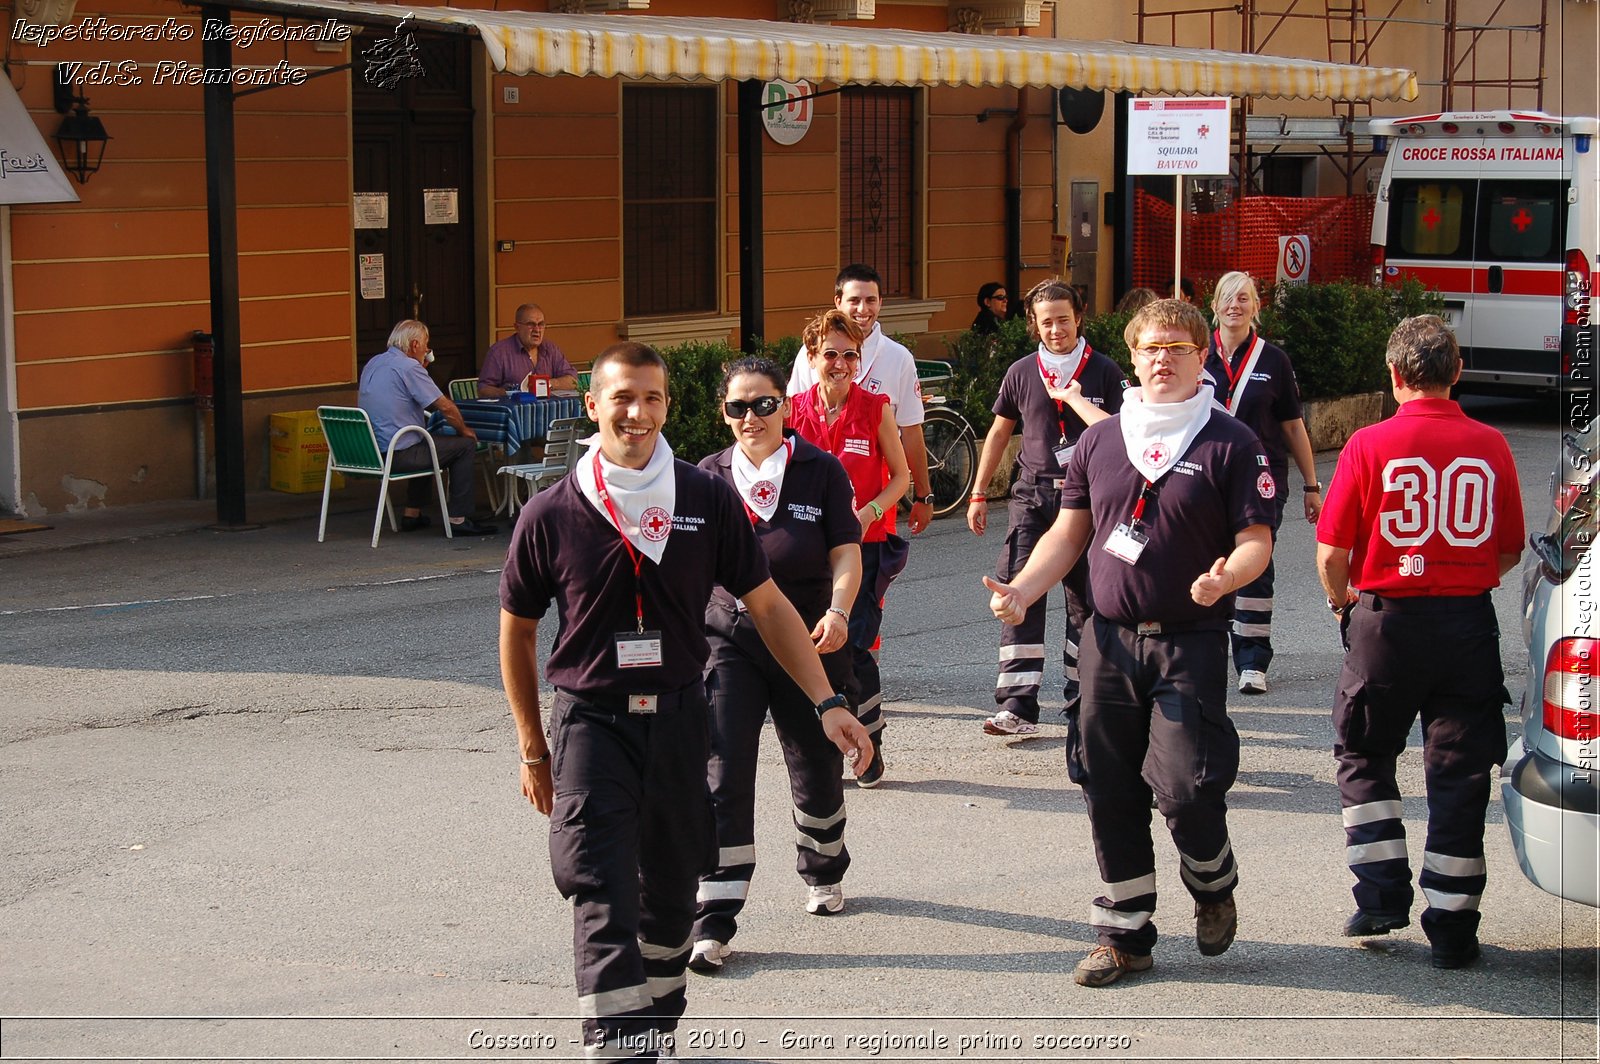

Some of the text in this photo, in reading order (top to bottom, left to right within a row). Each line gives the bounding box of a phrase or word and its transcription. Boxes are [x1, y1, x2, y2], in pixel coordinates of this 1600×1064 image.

[1157, 146, 1198, 156] SQUADRA
[1402, 147, 1565, 161] CROCE ROSSA ITALIANA
[1157, 160, 1198, 169] BAVENO
[1380, 457, 1495, 548] 30
[788, 503, 822, 516] CROCE ROSSA
[793, 512, 816, 522] ITALIANA
[1399, 554, 1424, 576] 30
